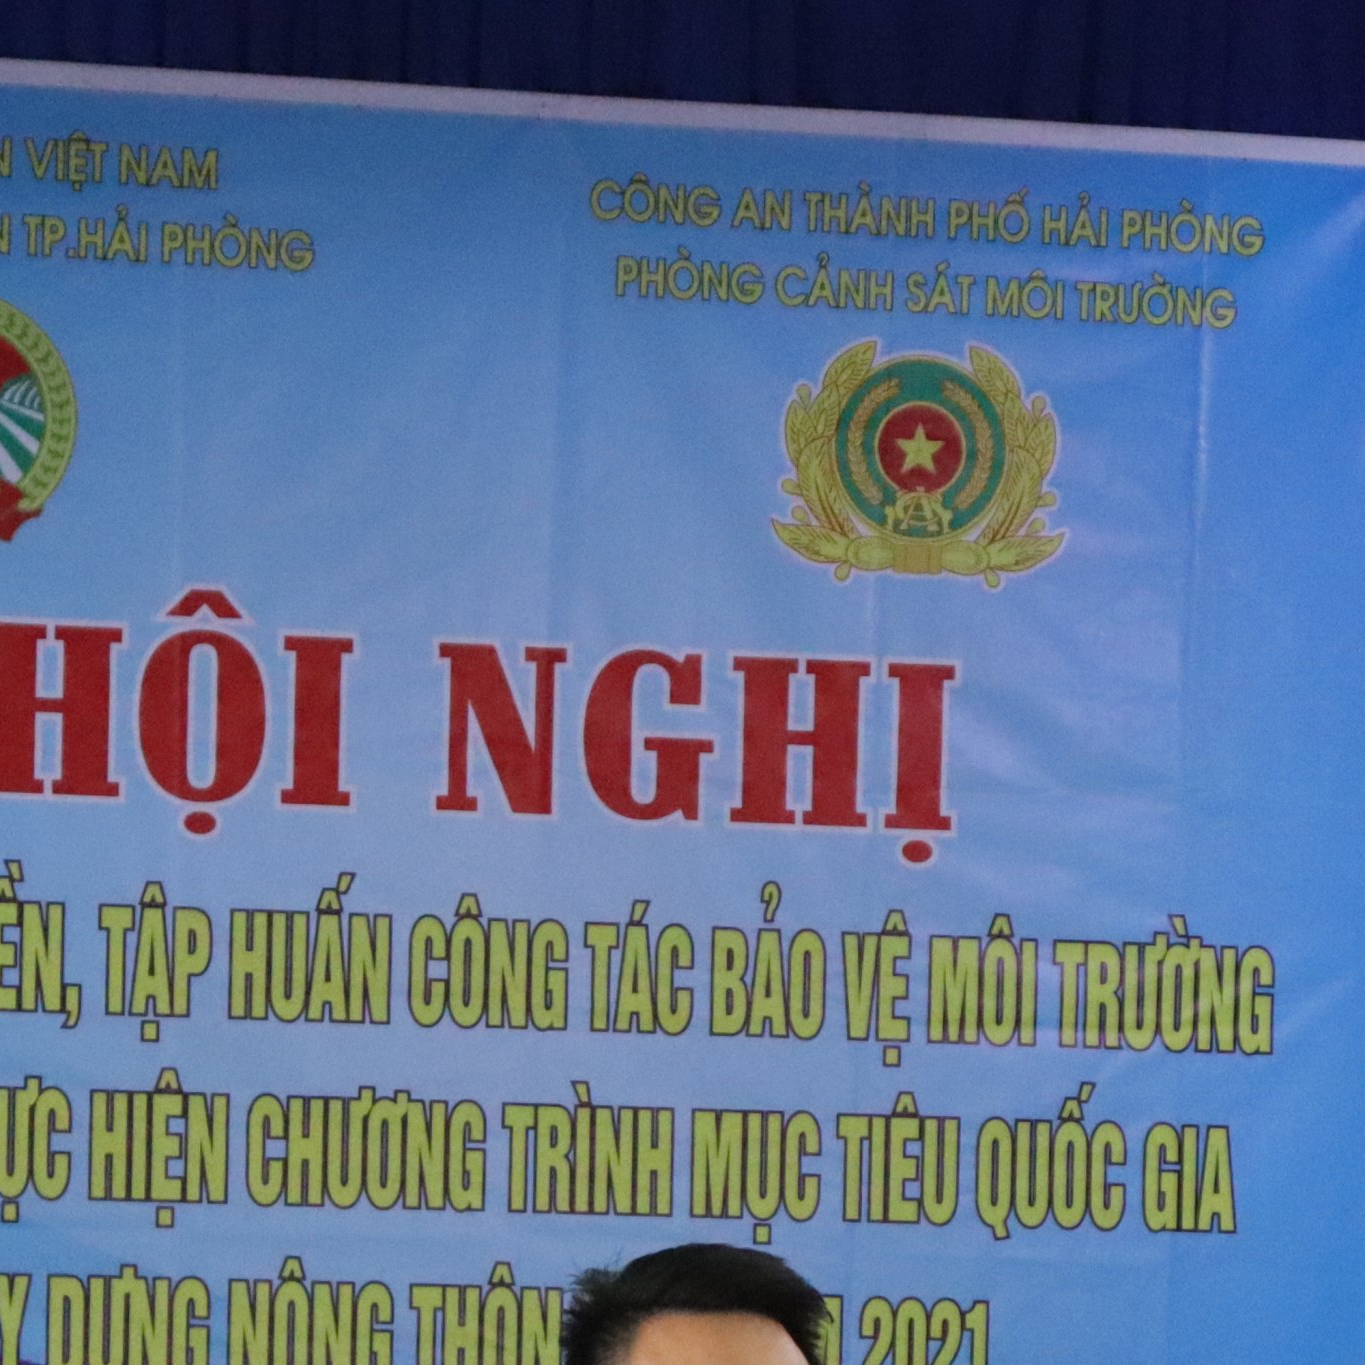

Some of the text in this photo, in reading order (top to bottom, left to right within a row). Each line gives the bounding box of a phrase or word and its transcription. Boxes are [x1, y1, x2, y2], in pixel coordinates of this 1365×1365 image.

[25, 131, 107, 191] VIỆT
[119, 144, 218, 190] NAM
[24, 205, 147, 263] TP.HẢI
[162, 213, 313, 271] PHÒNG
[590, 172, 1265, 257] CÔNG AN THÀNH PHỐ HẢI PHÒNG
[616, 247, 1236, 329] PHÒNG CẢNH SÁT MÔI TRƯỜNG
[435, 642, 956, 862] NGHỊ
[99, 880, 212, 1043] TẬP
[228, 872, 393, 1025] HUẤN
[409, 893, 569, 1031] CÔNG
[585, 900, 694, 1037] TÁC
[709, 881, 826, 1040] BẢO
[843, 909, 912, 1066] VỆ
[927, 913, 1038, 1047] MÔI
[1052, 914, 1275, 1057] TRƯỜNG
[88, 1068, 229, 1228] HIỆN
[245, 1086, 486, 1213] CHƯƠNG
[502, 1080, 674, 1216] TRÌNH
[691, 1110, 822, 1244] MỤC
[836, 1091, 960, 1226] TIÊU
[975, 1082, 1127, 1240] QUỐC
[1142, 1121, 1237, 1233] GIA
